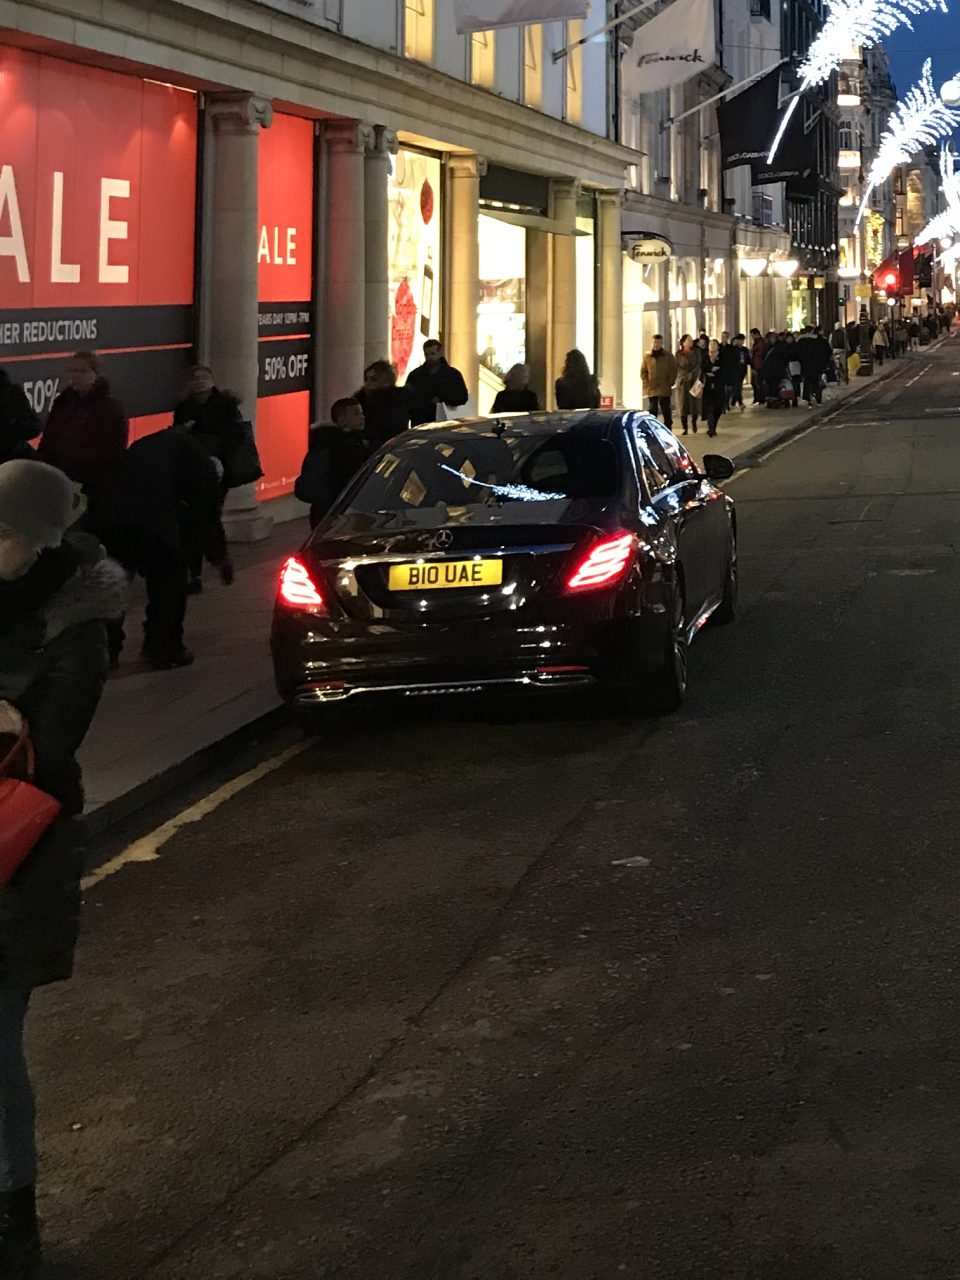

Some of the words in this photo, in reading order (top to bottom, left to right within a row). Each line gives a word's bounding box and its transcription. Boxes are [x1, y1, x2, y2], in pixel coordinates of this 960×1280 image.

[257, 225, 297, 265] ALE
[632, 244, 668, 260] Fenwick
[23, 319, 97, 343] REDUCTIONS
[265, 356, 286, 380] 50%
[288, 354, 308, 377] OFF
[408, 566, 439, 585] B10
[445, 563, 483, 583] UAE
